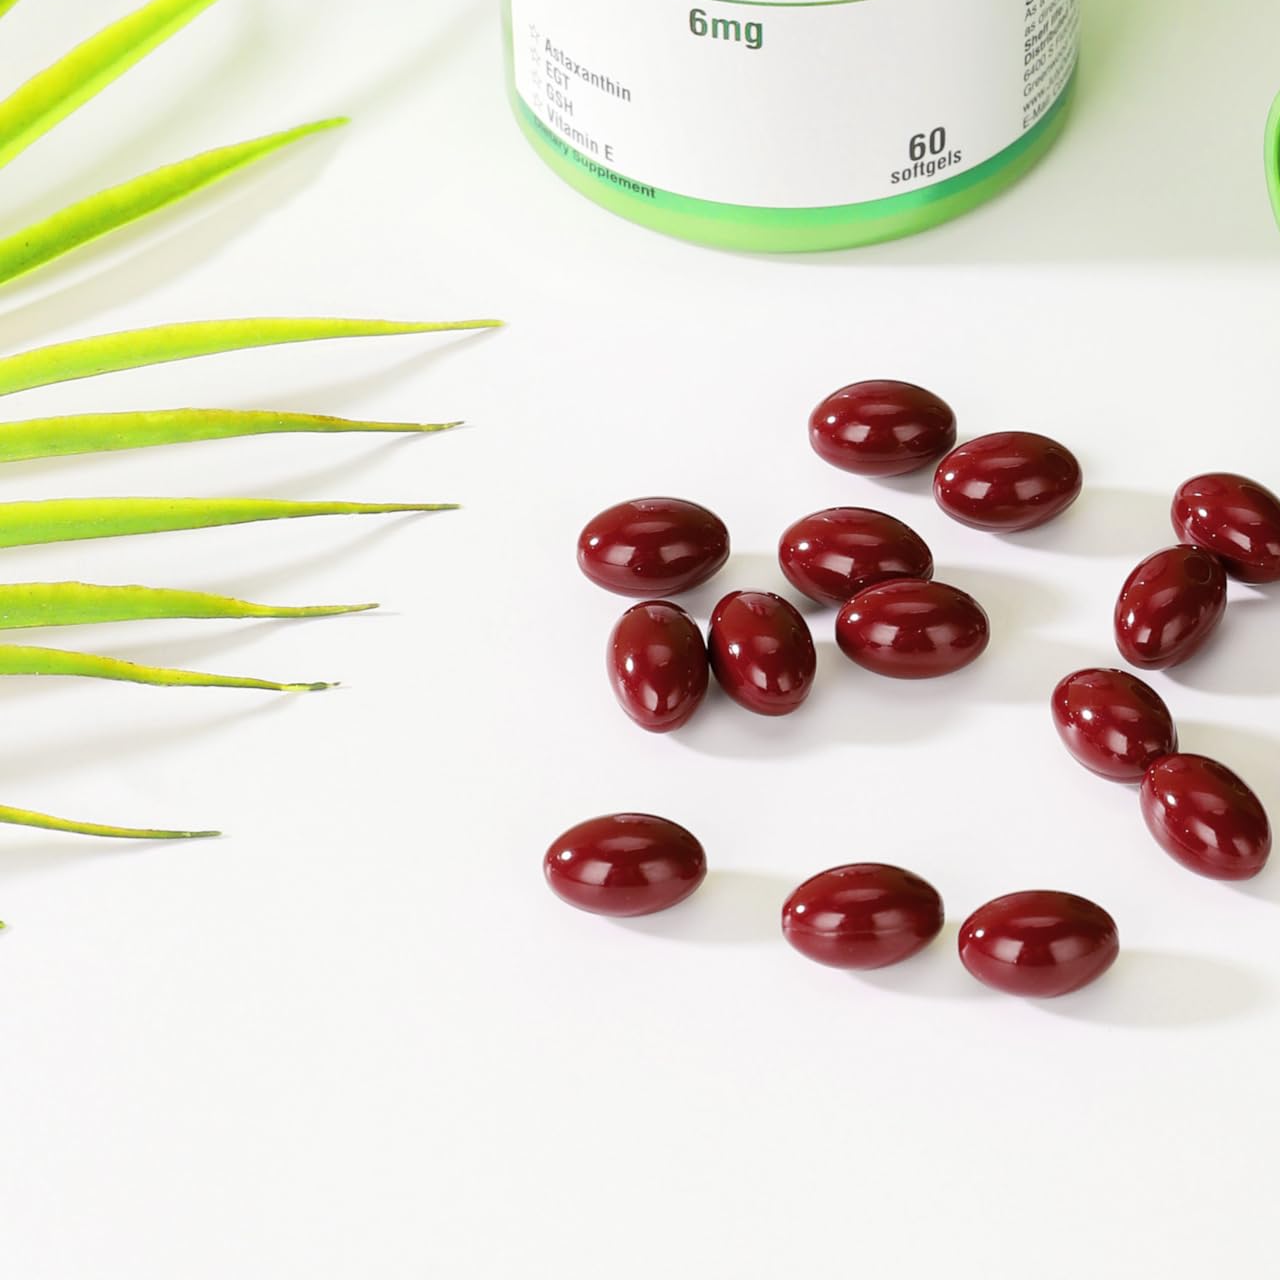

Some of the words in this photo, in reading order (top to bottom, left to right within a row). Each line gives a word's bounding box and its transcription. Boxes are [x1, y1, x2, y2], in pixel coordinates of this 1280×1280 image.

[688, 8, 764, 50] 6mg
[545, 38, 631, 102] Astaxanthin
[546, 60, 570, 90] EGT
[546, 83, 574, 116] GSH
[547, 104, 599, 154] Vitamin
[604, 144, 614, 162] E
[908, 126, 946, 162] 60
[573, 149, 657, 199] Supplement
[890, 147, 962, 185] softgels
